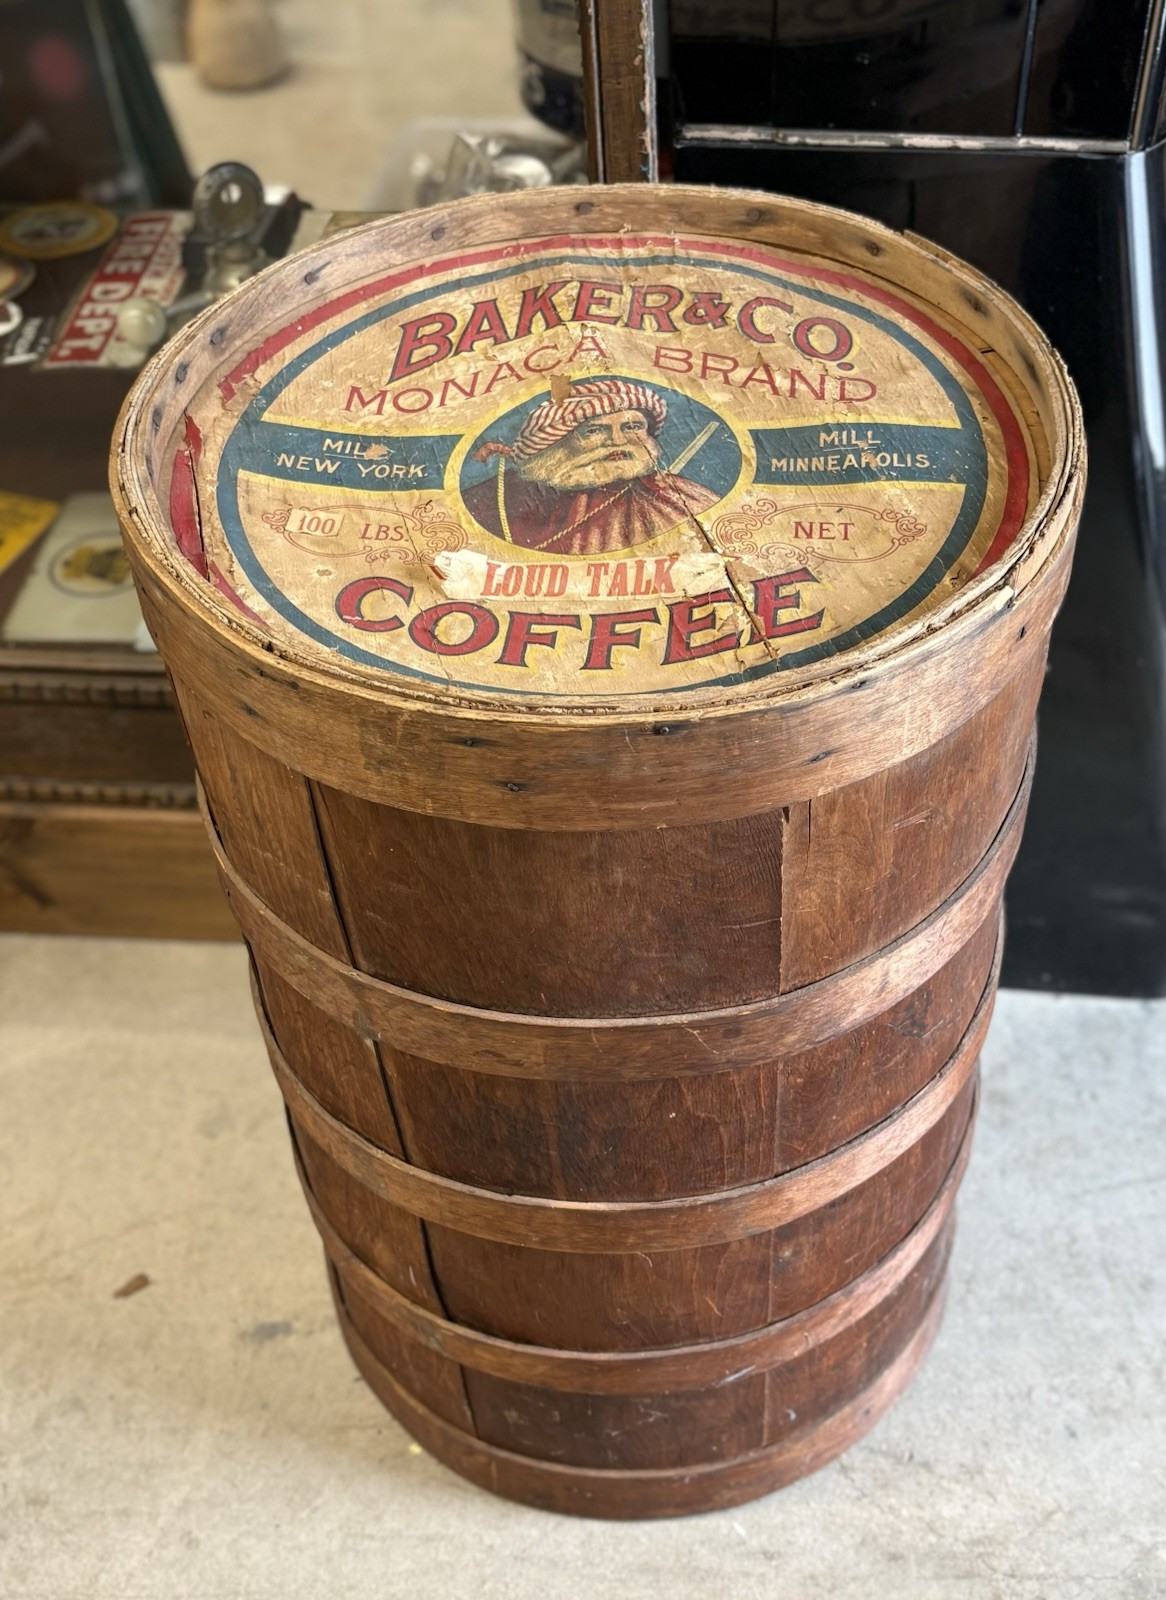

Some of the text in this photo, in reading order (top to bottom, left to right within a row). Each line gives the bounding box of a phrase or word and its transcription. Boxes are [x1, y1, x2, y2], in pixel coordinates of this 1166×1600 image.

[56, 281, 134, 357] DEPT.
[344, 335, 878, 416] MONACA BRAND
[322, 438, 388, 458] MIL
[818, 429, 882, 448] MILL
[276, 453, 341, 475] NEW
[298, 512, 336, 535] 100
[792, 521, 855, 542] NET
[480, 554, 679, 598] LOUD TALK
[334, 567, 826, 670] COFFEE
